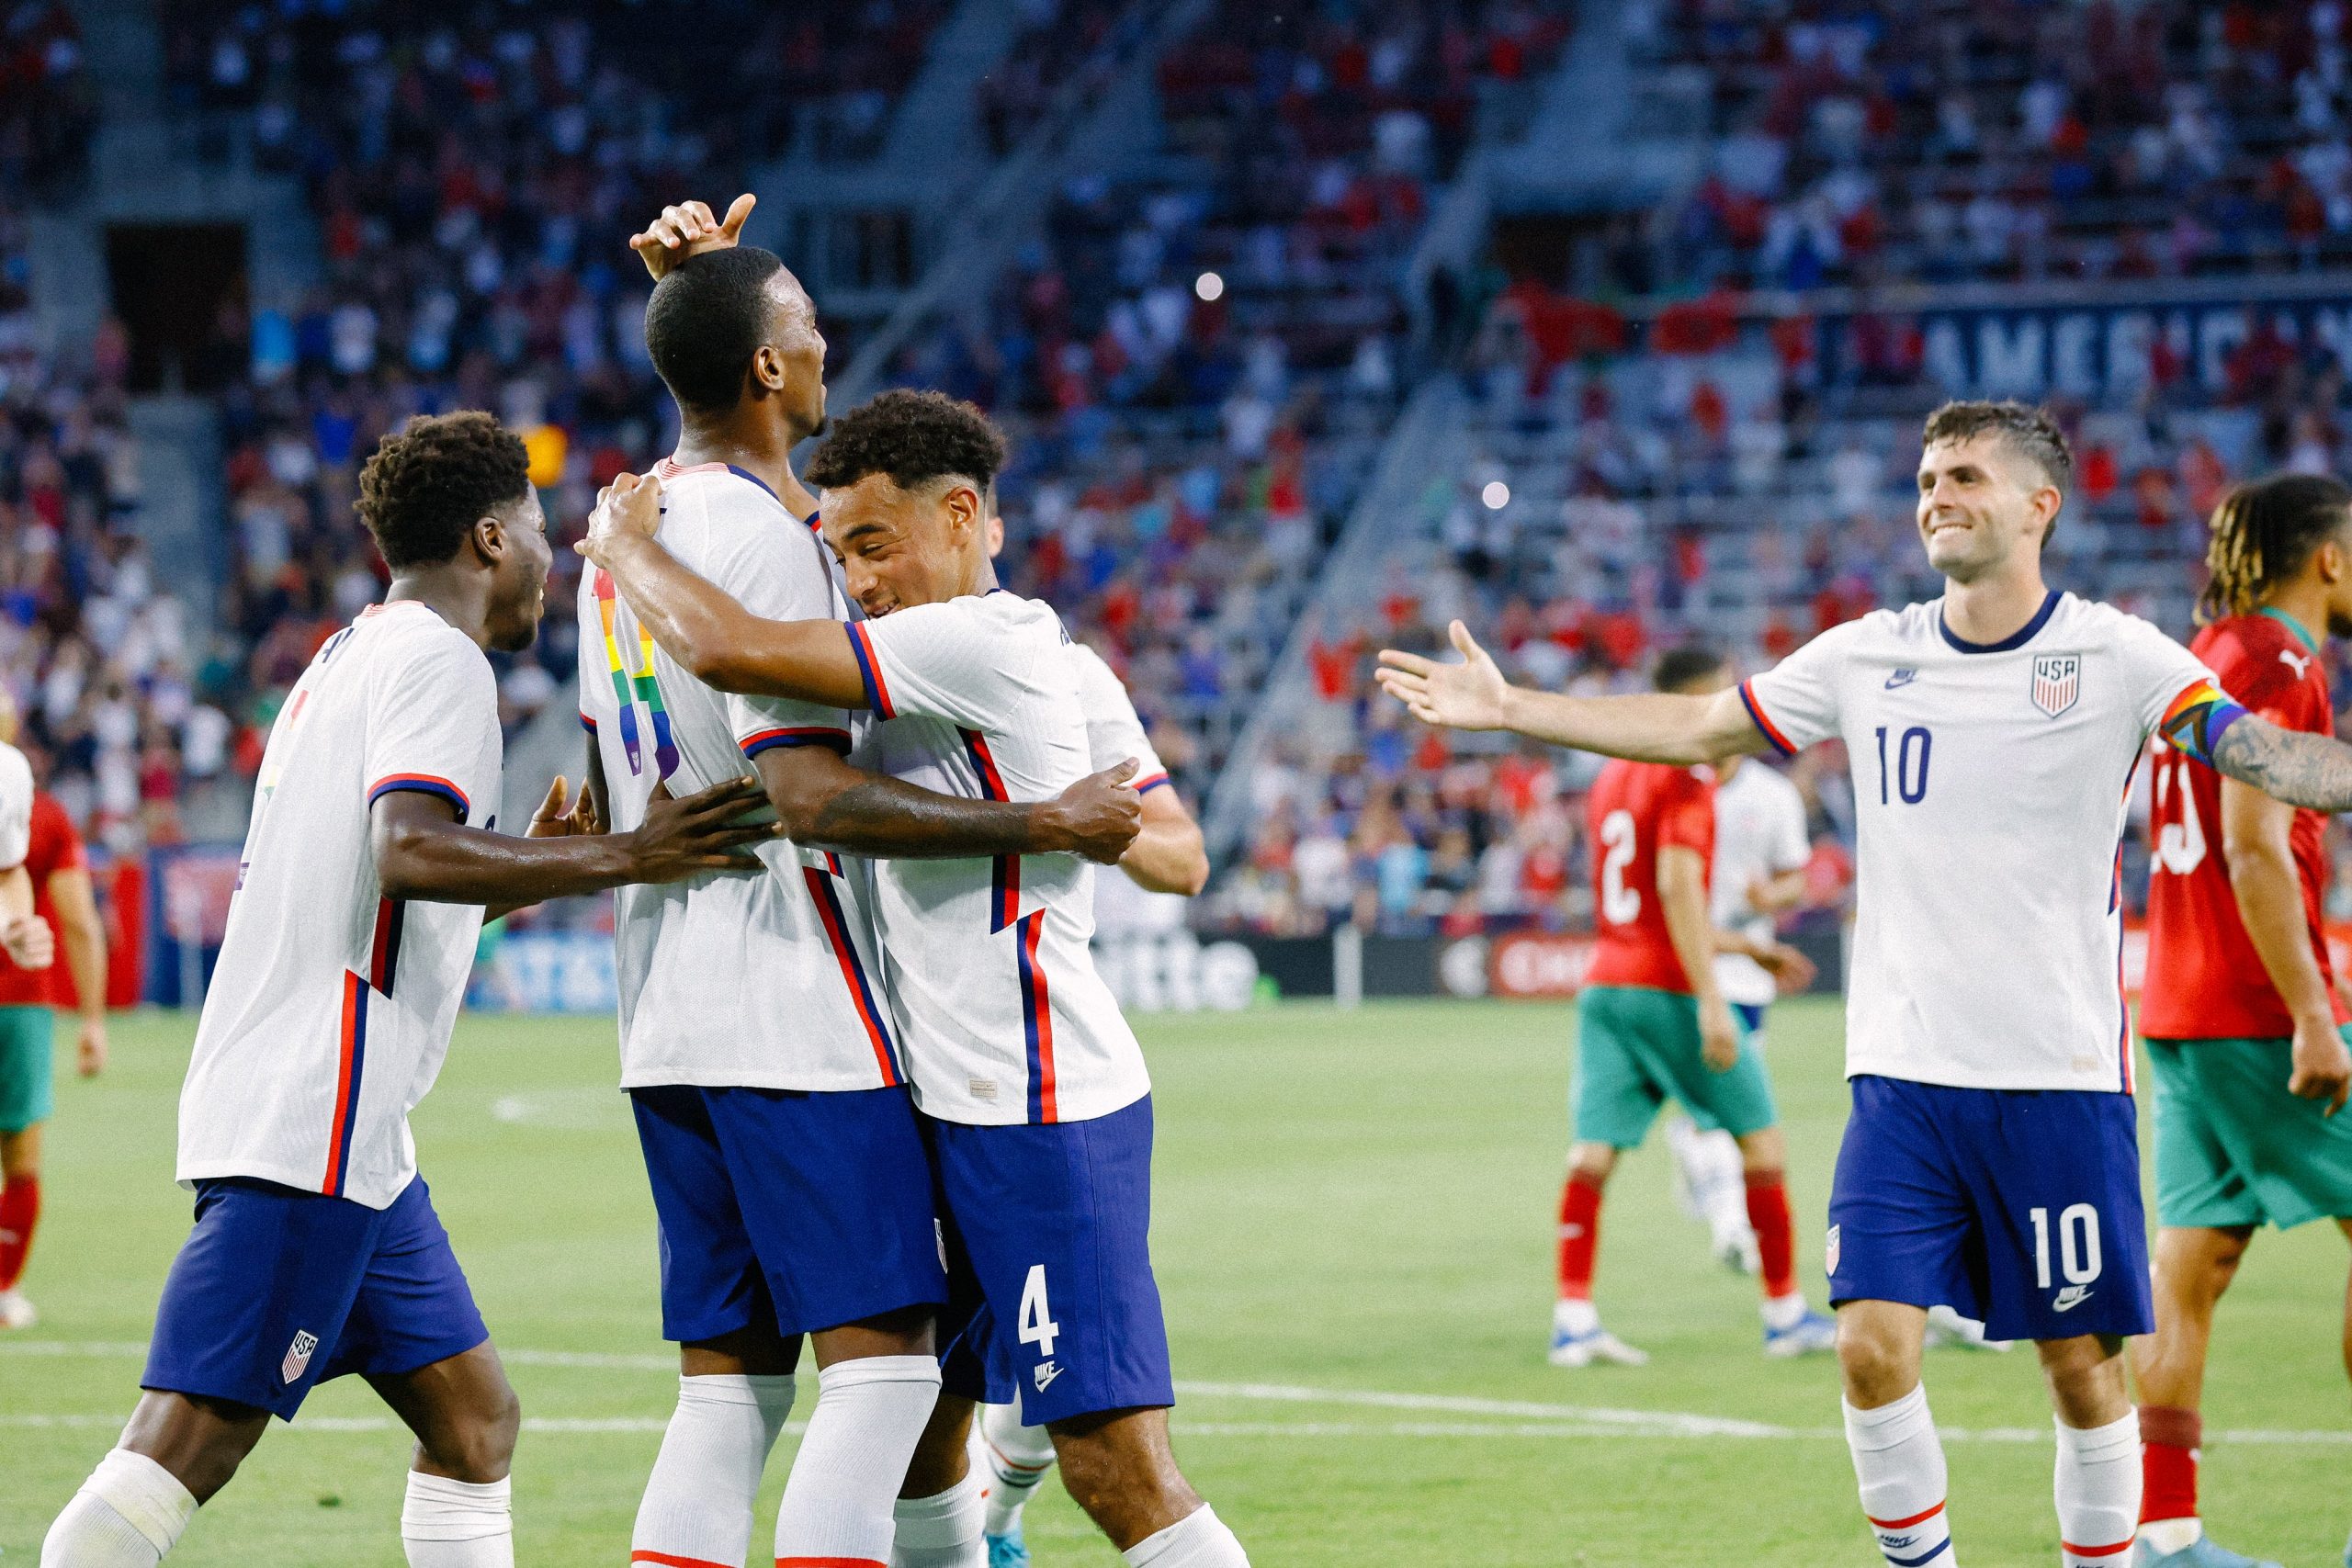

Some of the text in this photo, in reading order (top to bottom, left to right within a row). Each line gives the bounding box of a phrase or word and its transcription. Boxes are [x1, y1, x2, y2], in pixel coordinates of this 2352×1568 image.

[2038, 660, 2075, 682] USA
[1876, 727, 1932, 805] 10
[1601, 809, 1641, 925] 2
[2030, 1203, 2102, 1288] 10
[294, 1332, 316, 1355] USA
[1018, 1264, 1058, 1357] 4
[1034, 1360, 1057, 1384] NIKE
